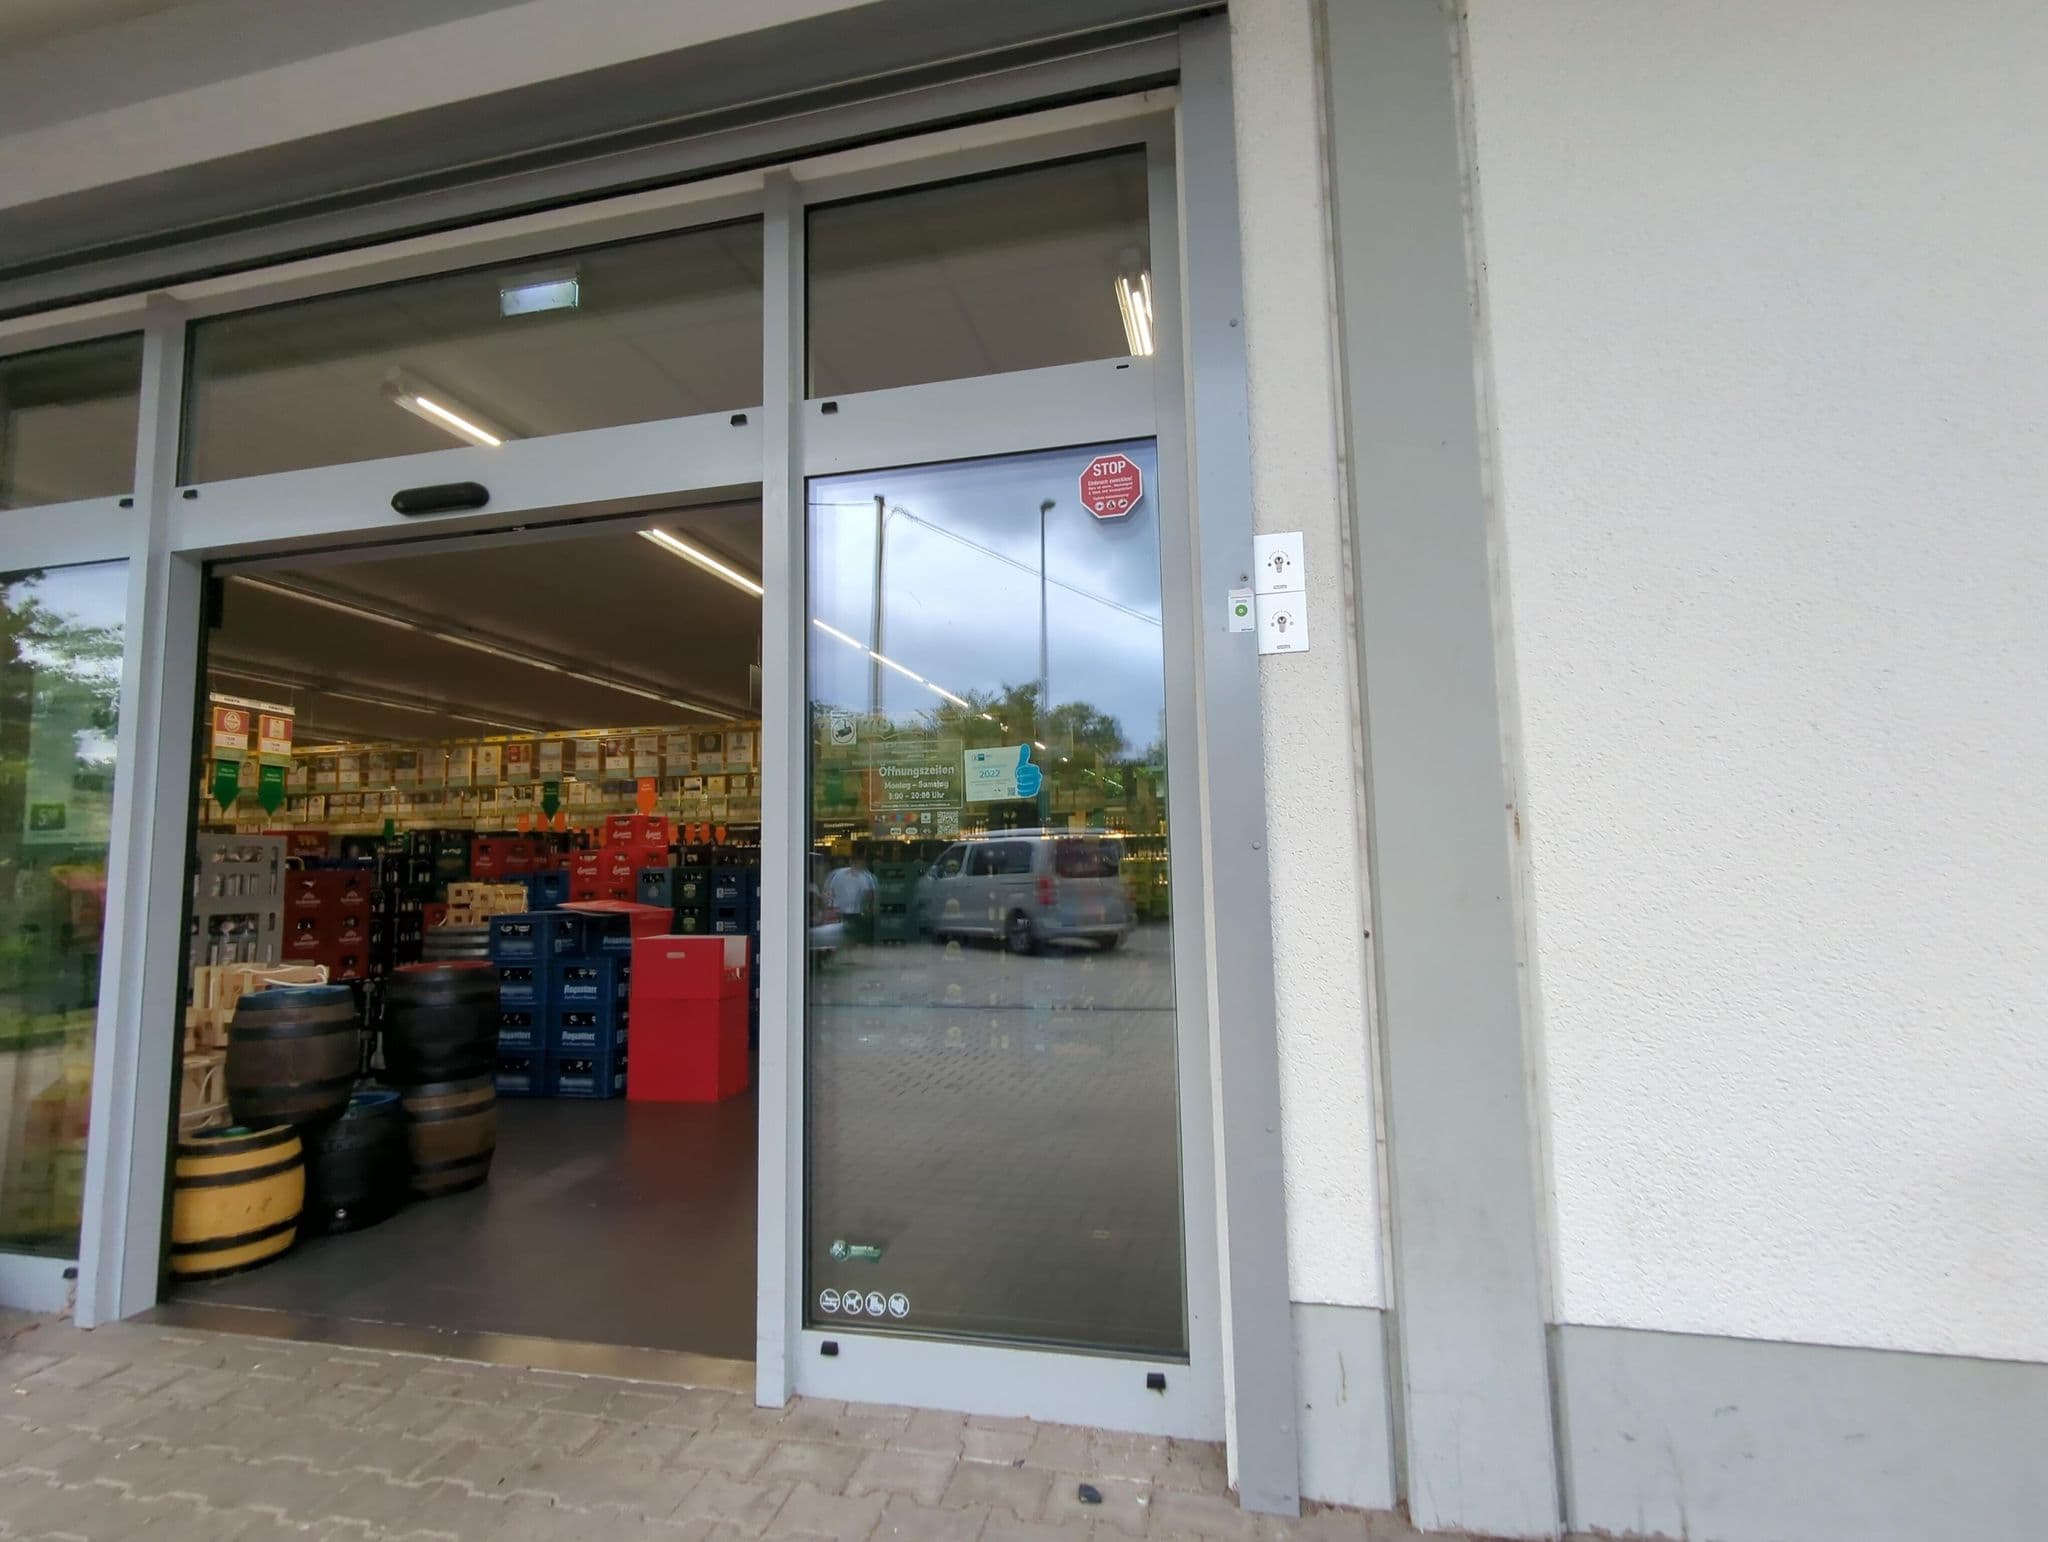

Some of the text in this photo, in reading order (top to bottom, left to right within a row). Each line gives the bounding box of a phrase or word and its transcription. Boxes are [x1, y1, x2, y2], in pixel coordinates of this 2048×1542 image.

[1093, 460, 1126, 477] STOP
[879, 763, 955, 778] Öffnungszeiten
[979, 770, 1001, 778] 2022
[884, 781, 911, 790] Montag
[918, 780, 950, 789] Samstag
